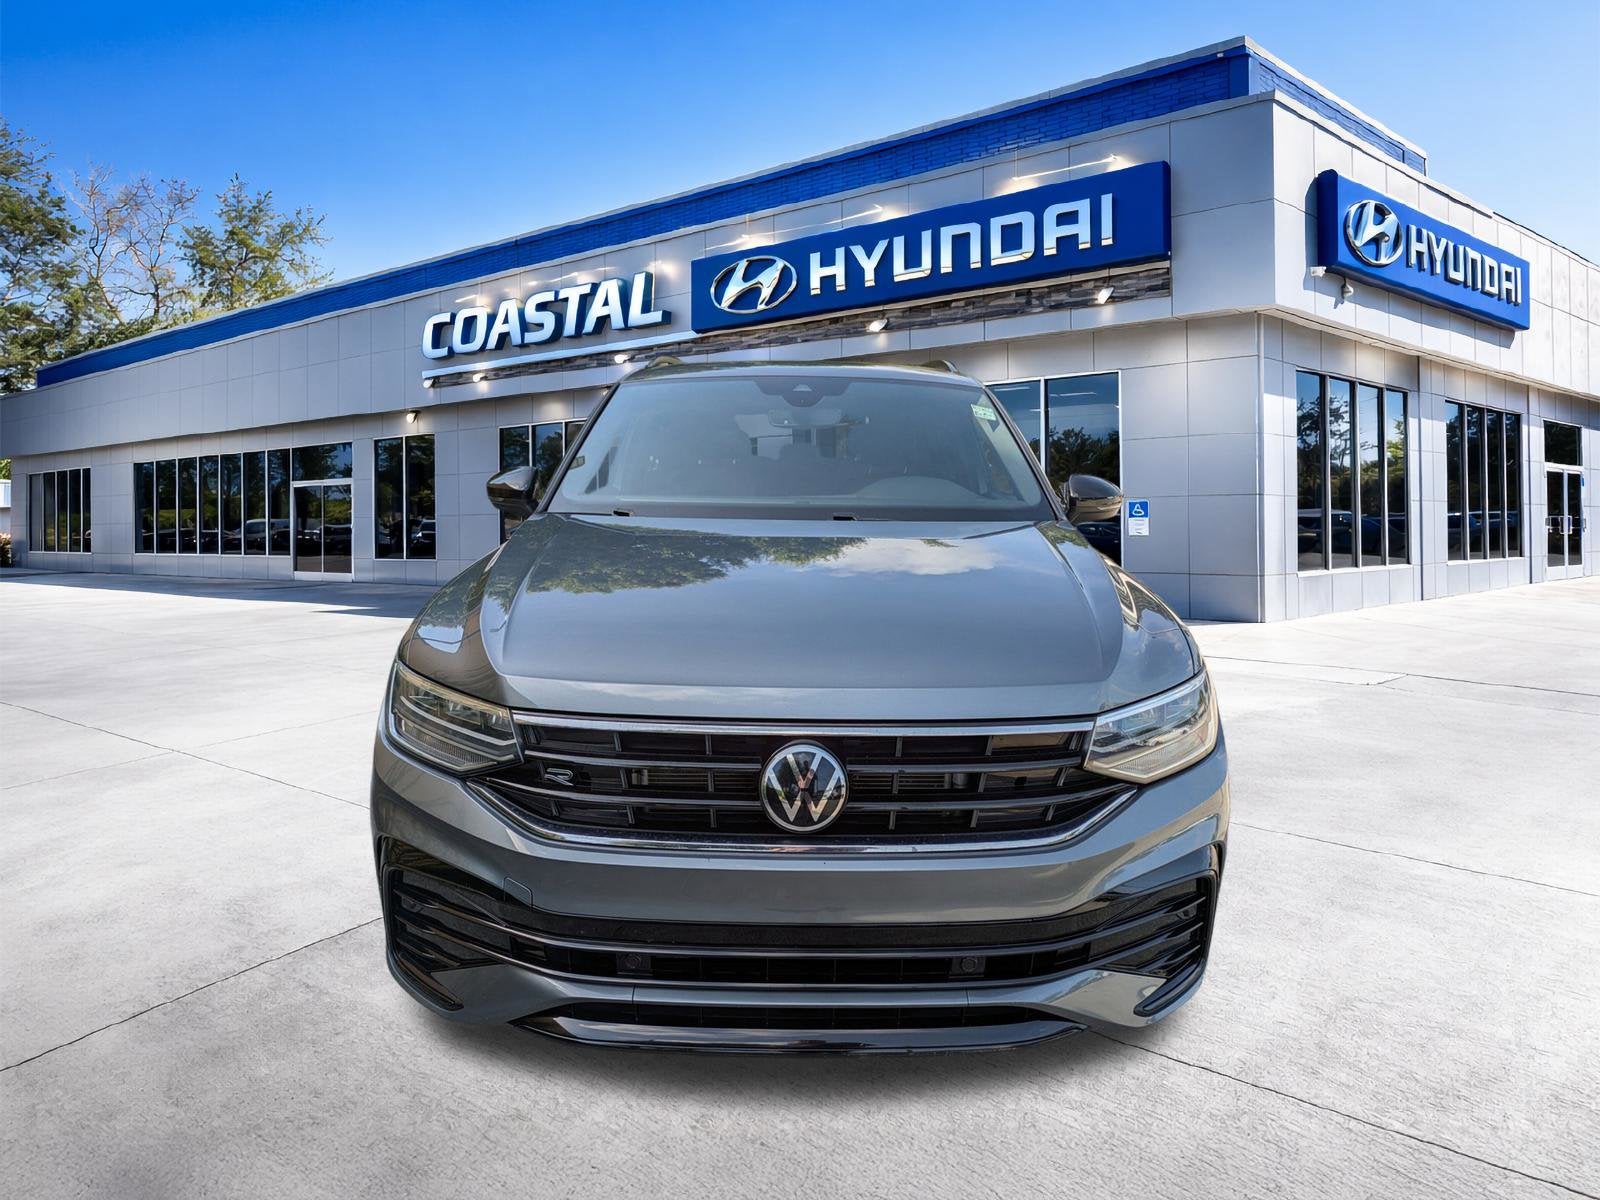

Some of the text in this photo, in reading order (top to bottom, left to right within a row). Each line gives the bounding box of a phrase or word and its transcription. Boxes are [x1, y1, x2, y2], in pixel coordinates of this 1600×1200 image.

[809, 193, 1114, 296] HYUNDAI
[1406, 224, 1522, 307] HYUNDAI
[422, 271, 668, 359] COASTAL
